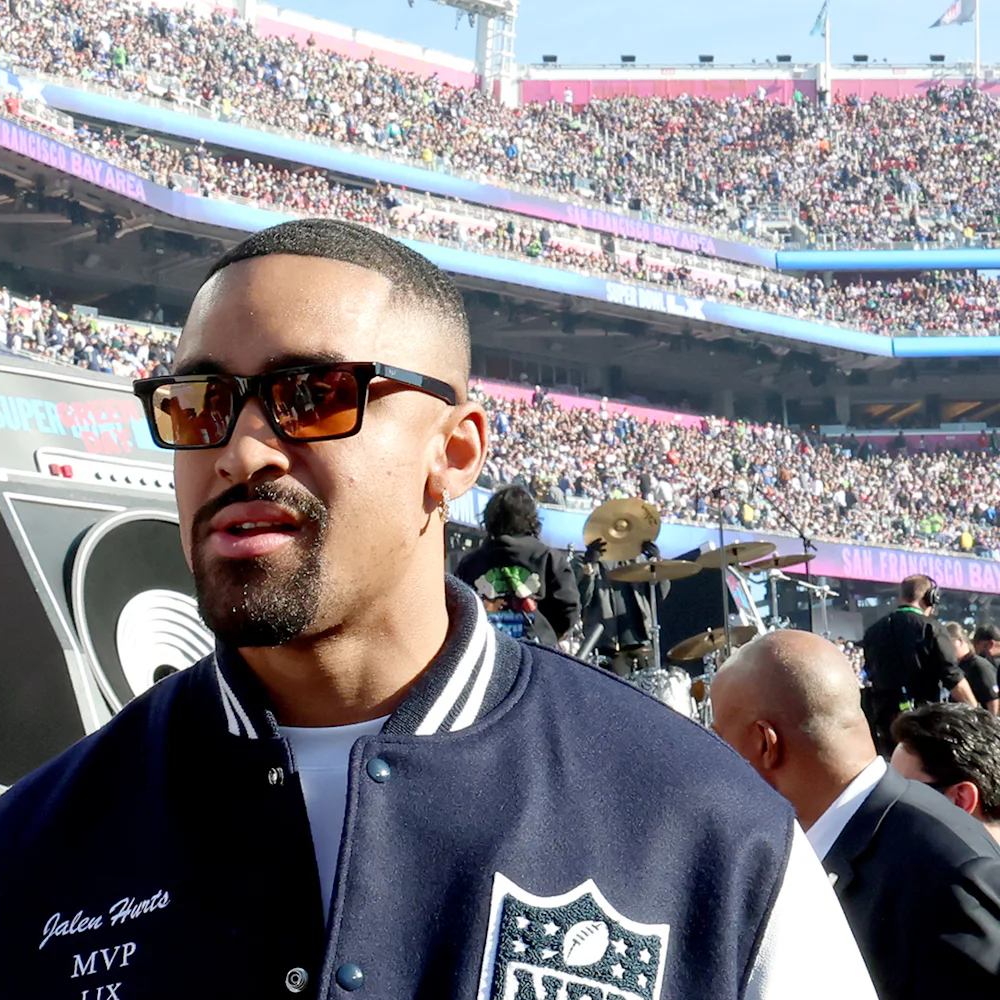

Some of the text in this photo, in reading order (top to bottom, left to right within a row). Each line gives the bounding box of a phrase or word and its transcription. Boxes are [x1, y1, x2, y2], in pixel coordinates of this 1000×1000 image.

[70, 152, 103, 184] BAY
[104, 166, 147, 201] AREA
[566, 205, 716, 254] SAN FRANCISCO BAY AREA
[666, 294, 706, 320] LX
[79, 426, 133, 454] DAY
[842, 547, 873, 577] SAN
[879, 551, 964, 587] FRANCISCO
[38, 888, 171, 950] Jalen Hurts
[70, 941, 137, 979] MVP
